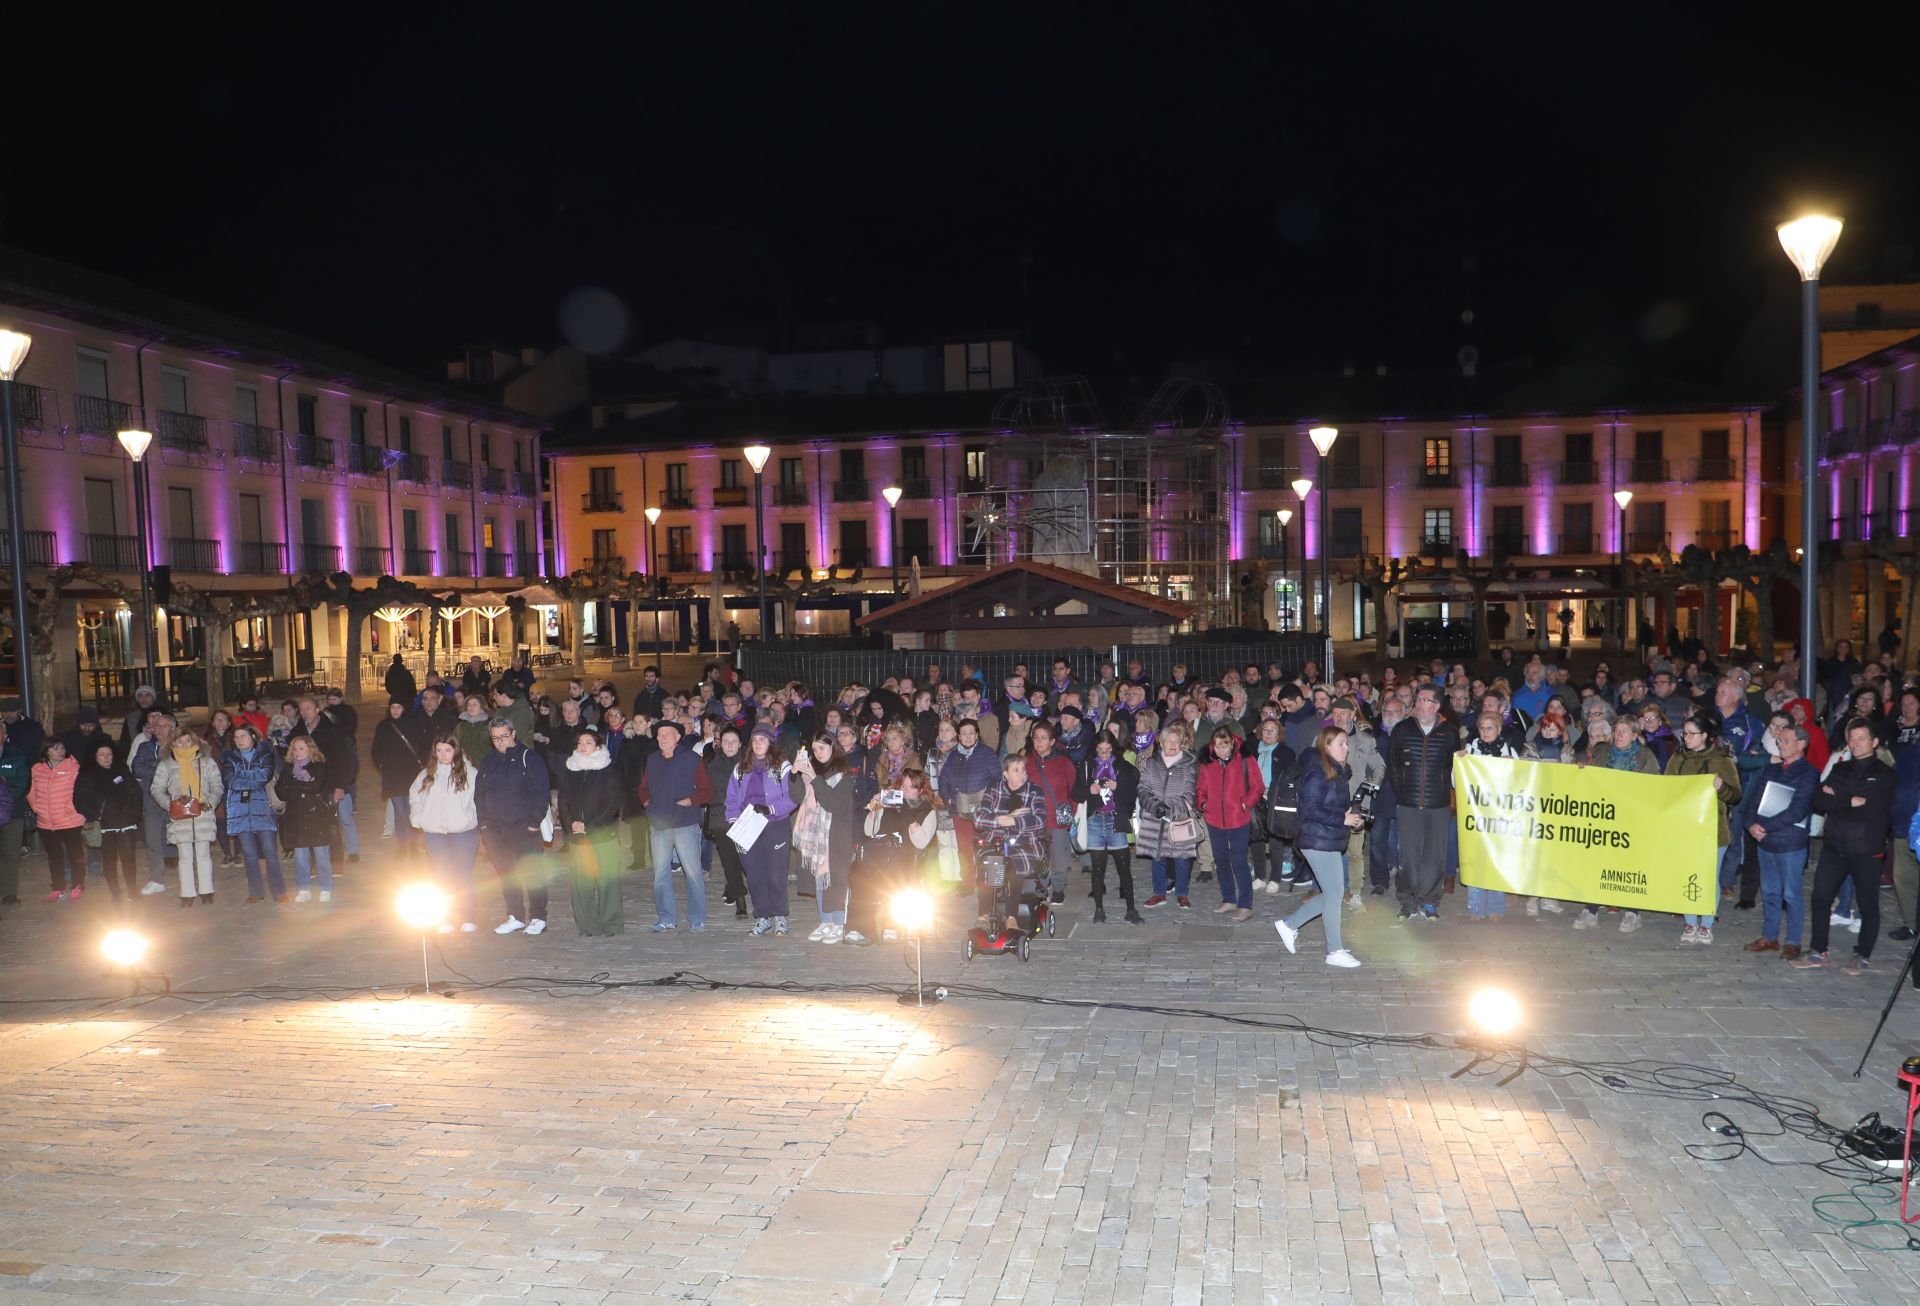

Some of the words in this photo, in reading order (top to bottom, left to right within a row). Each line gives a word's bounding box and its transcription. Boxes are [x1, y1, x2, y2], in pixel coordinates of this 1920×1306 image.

[1467, 784, 1491, 807] No
[1497, 789, 1535, 812] más
[1540, 793, 1616, 820] violencia
[1465, 814, 1524, 837] contra
[1529, 818, 1555, 840] las
[1559, 823, 1631, 849] mujeres
[1600, 869, 1648, 886] AMNISTÍA
[1600, 882, 1648, 896] INTERNACIONAL
